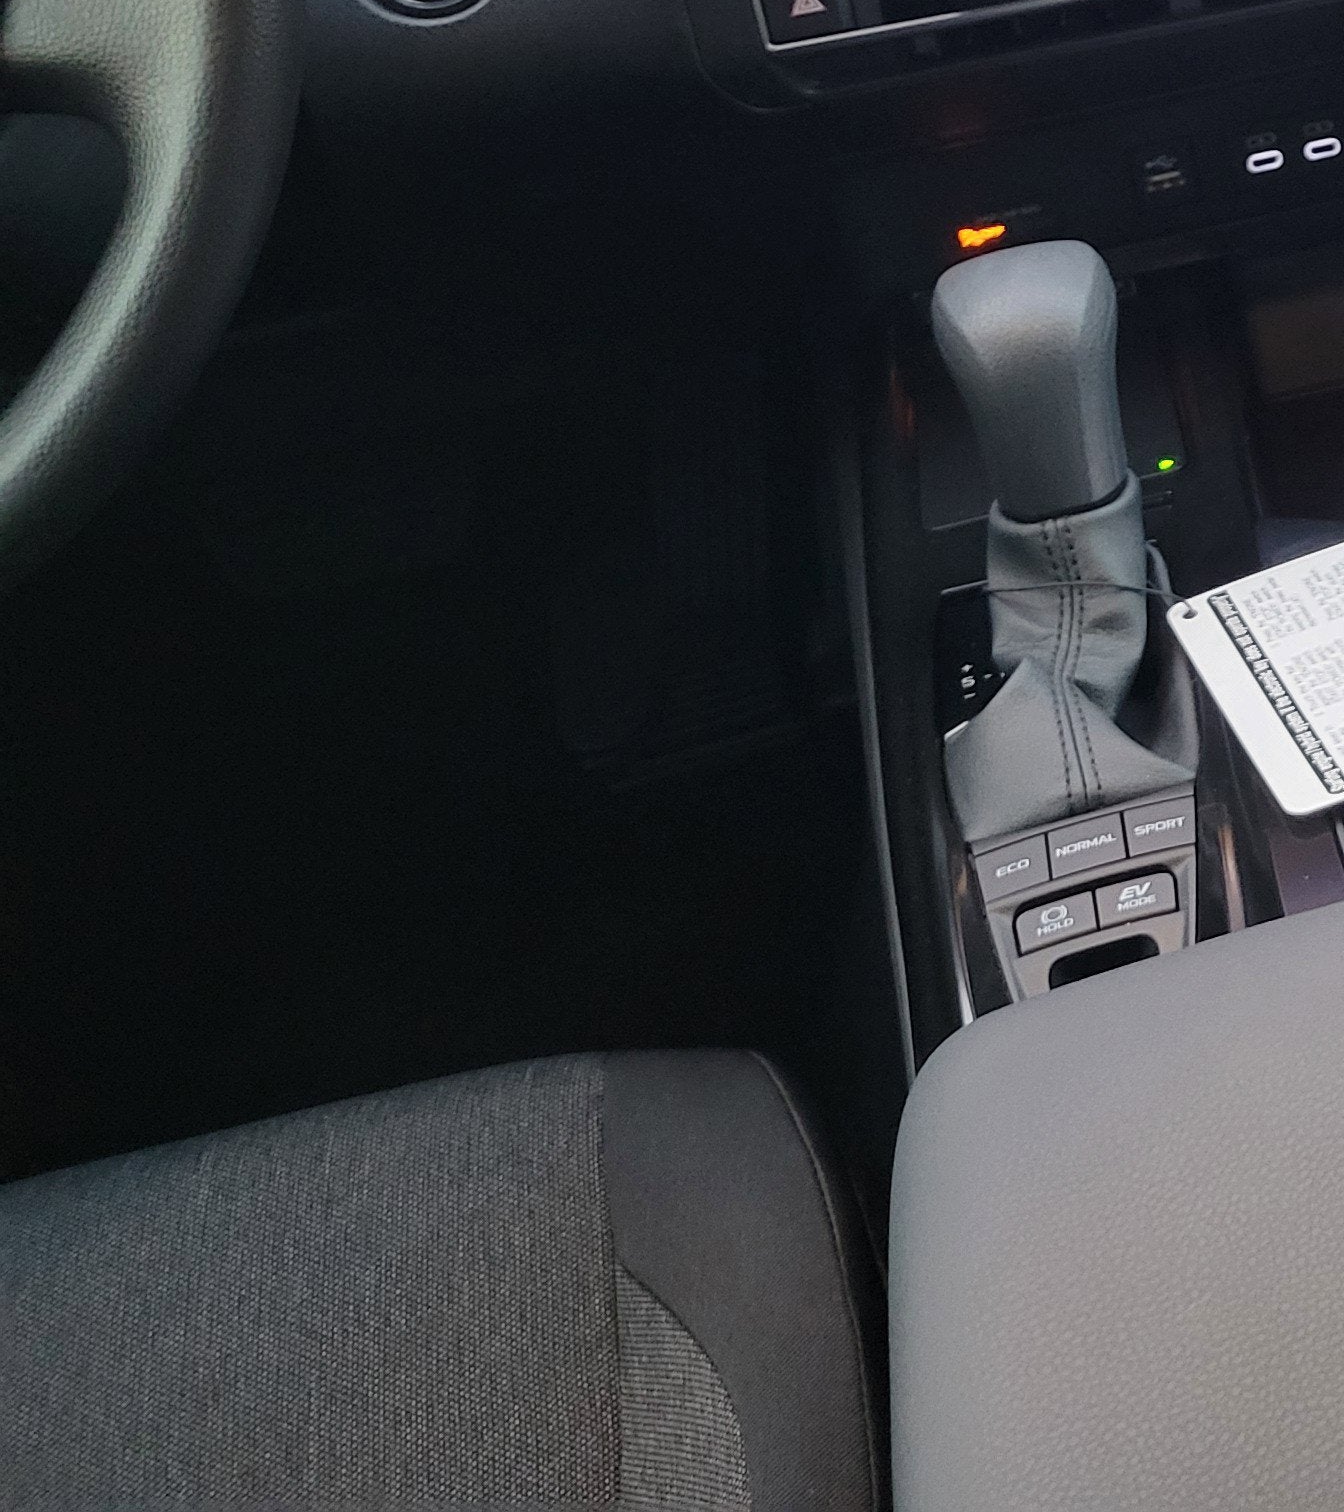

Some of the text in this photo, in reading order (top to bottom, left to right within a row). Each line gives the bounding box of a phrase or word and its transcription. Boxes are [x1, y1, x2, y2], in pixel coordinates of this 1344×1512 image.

[1133, 816, 1186, 837] SPORT
[1055, 833, 1117, 858] NORMAL
[995, 858, 1030, 878] ECO
[1119, 881, 1151, 902] EV
[1117, 895, 1157, 913] MODE
[1037, 917, 1075, 937] HOLD
